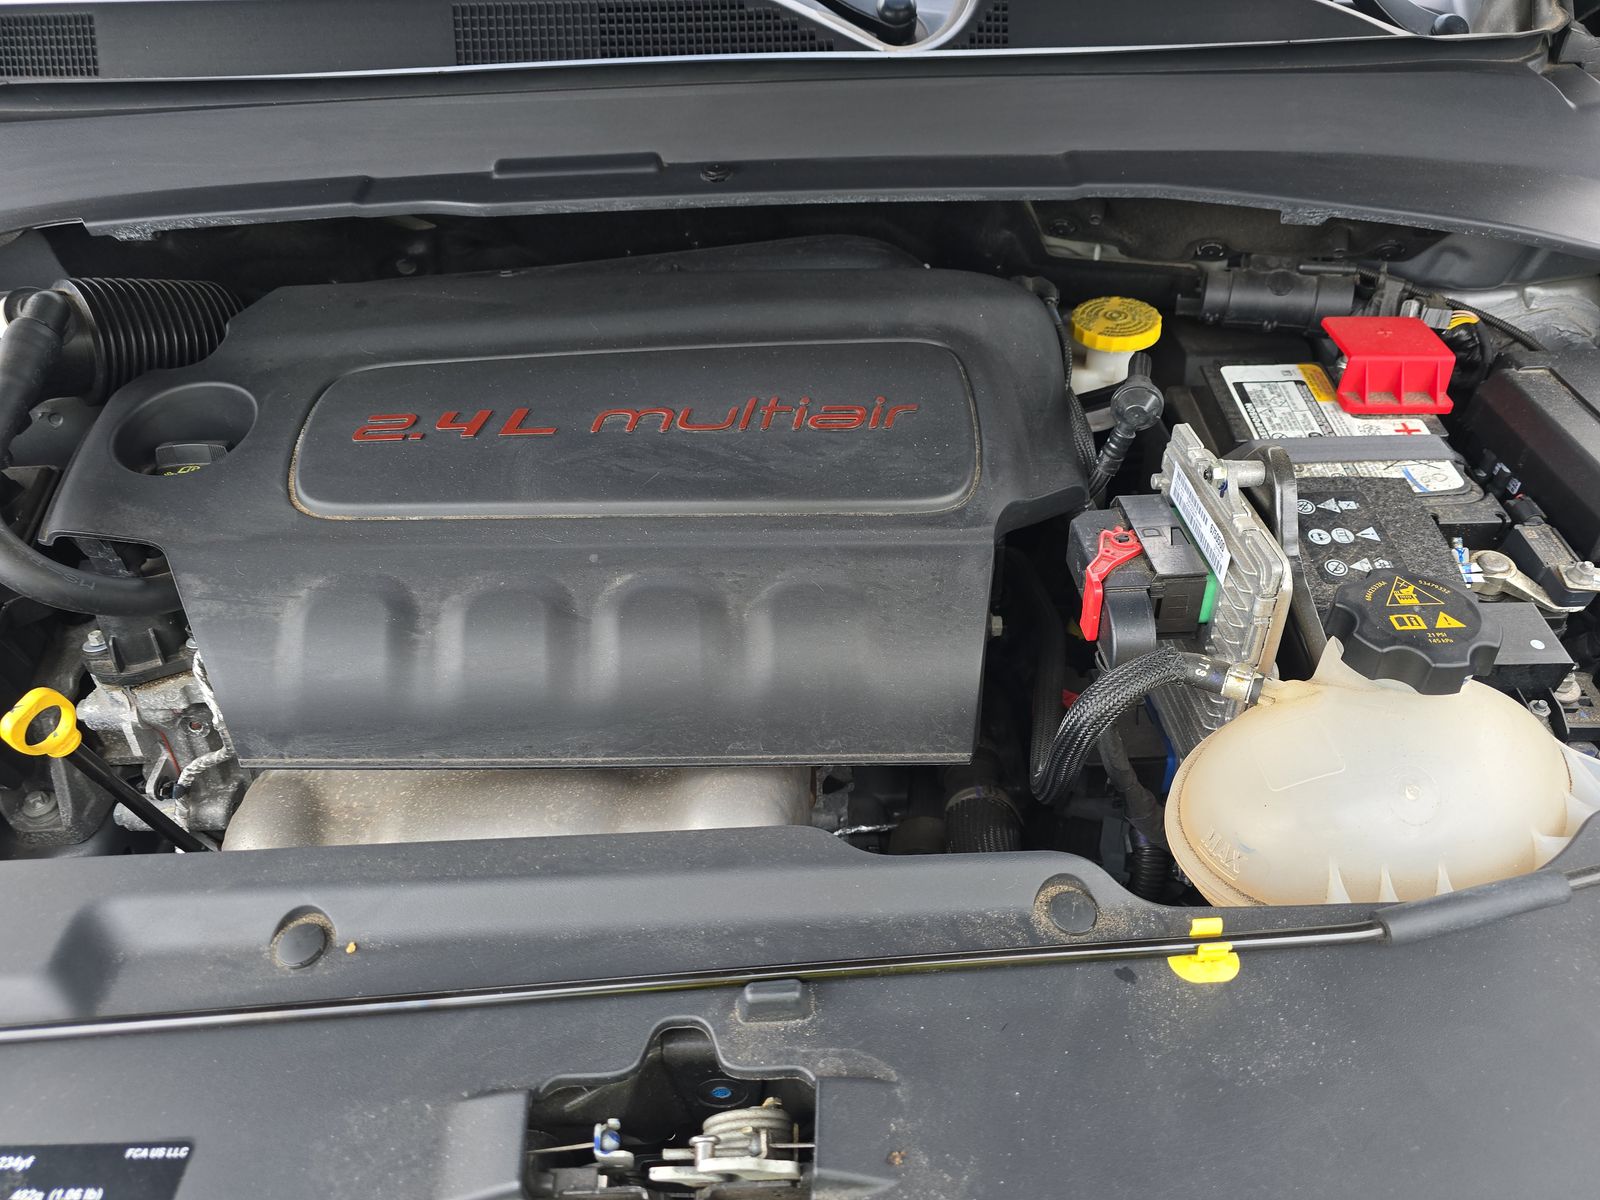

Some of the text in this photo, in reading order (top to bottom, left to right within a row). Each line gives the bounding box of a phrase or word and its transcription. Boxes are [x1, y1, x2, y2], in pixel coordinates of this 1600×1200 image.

[589, 394, 920, 435] multiair
[1200, 831, 1241, 874] MAX
[124, 1146, 190, 1159] FCA US LLC
